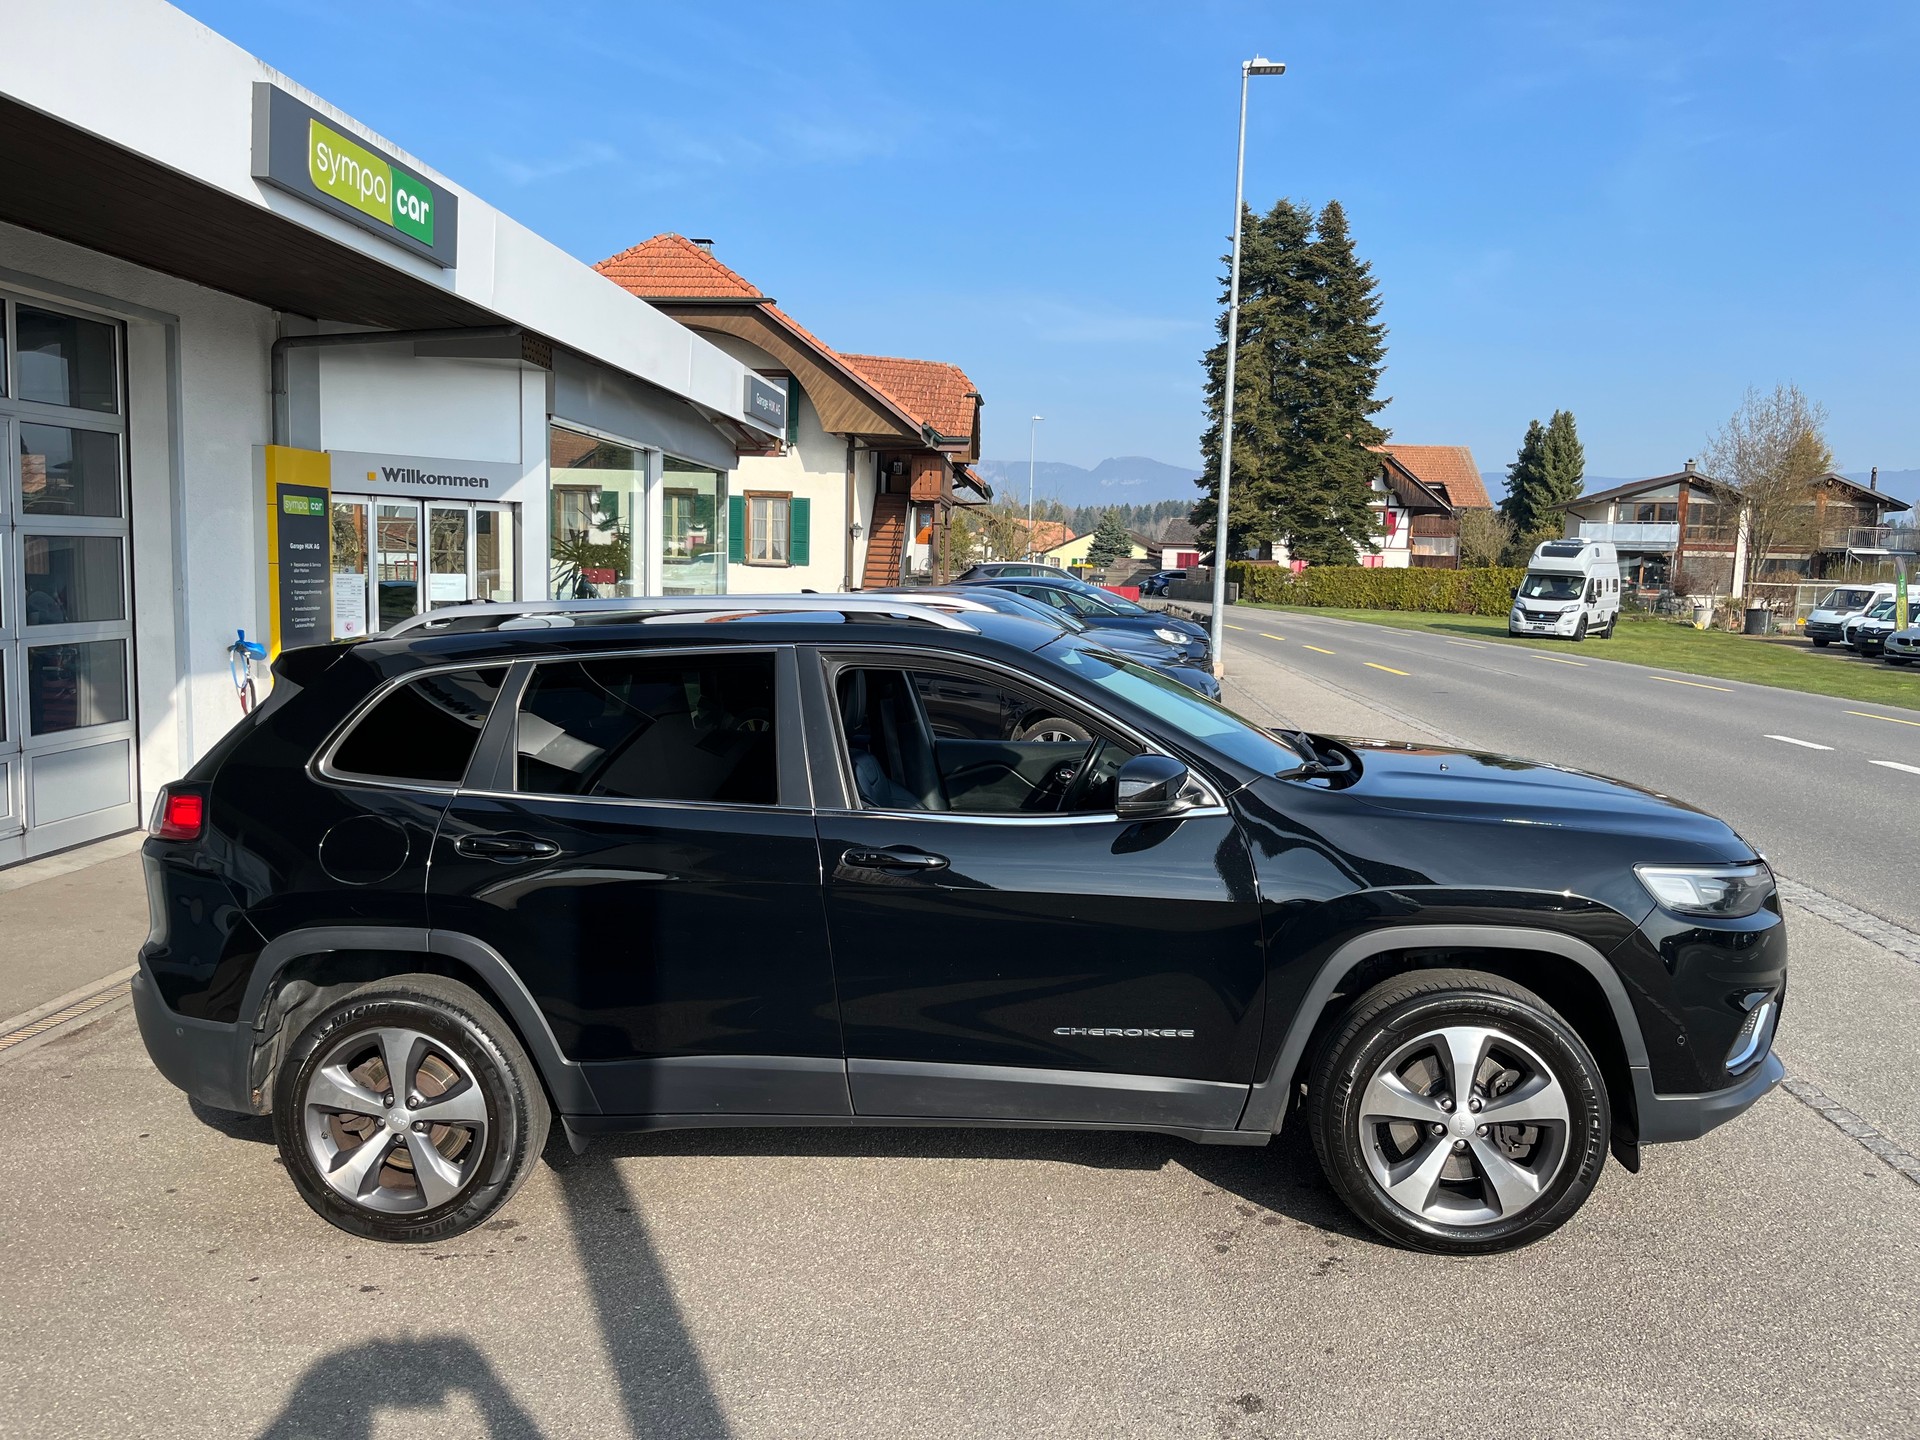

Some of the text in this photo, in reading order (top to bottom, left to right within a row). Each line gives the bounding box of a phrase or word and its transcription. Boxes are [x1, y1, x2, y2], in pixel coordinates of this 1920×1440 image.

[316, 142, 430, 225] sympa car
[381, 466, 489, 488] Willkommen
[285, 500, 322, 512] sympa car
[1053, 1027, 1195, 1037] CHEROKEE
[1578, 1087, 1601, 1188] MICHELIN
